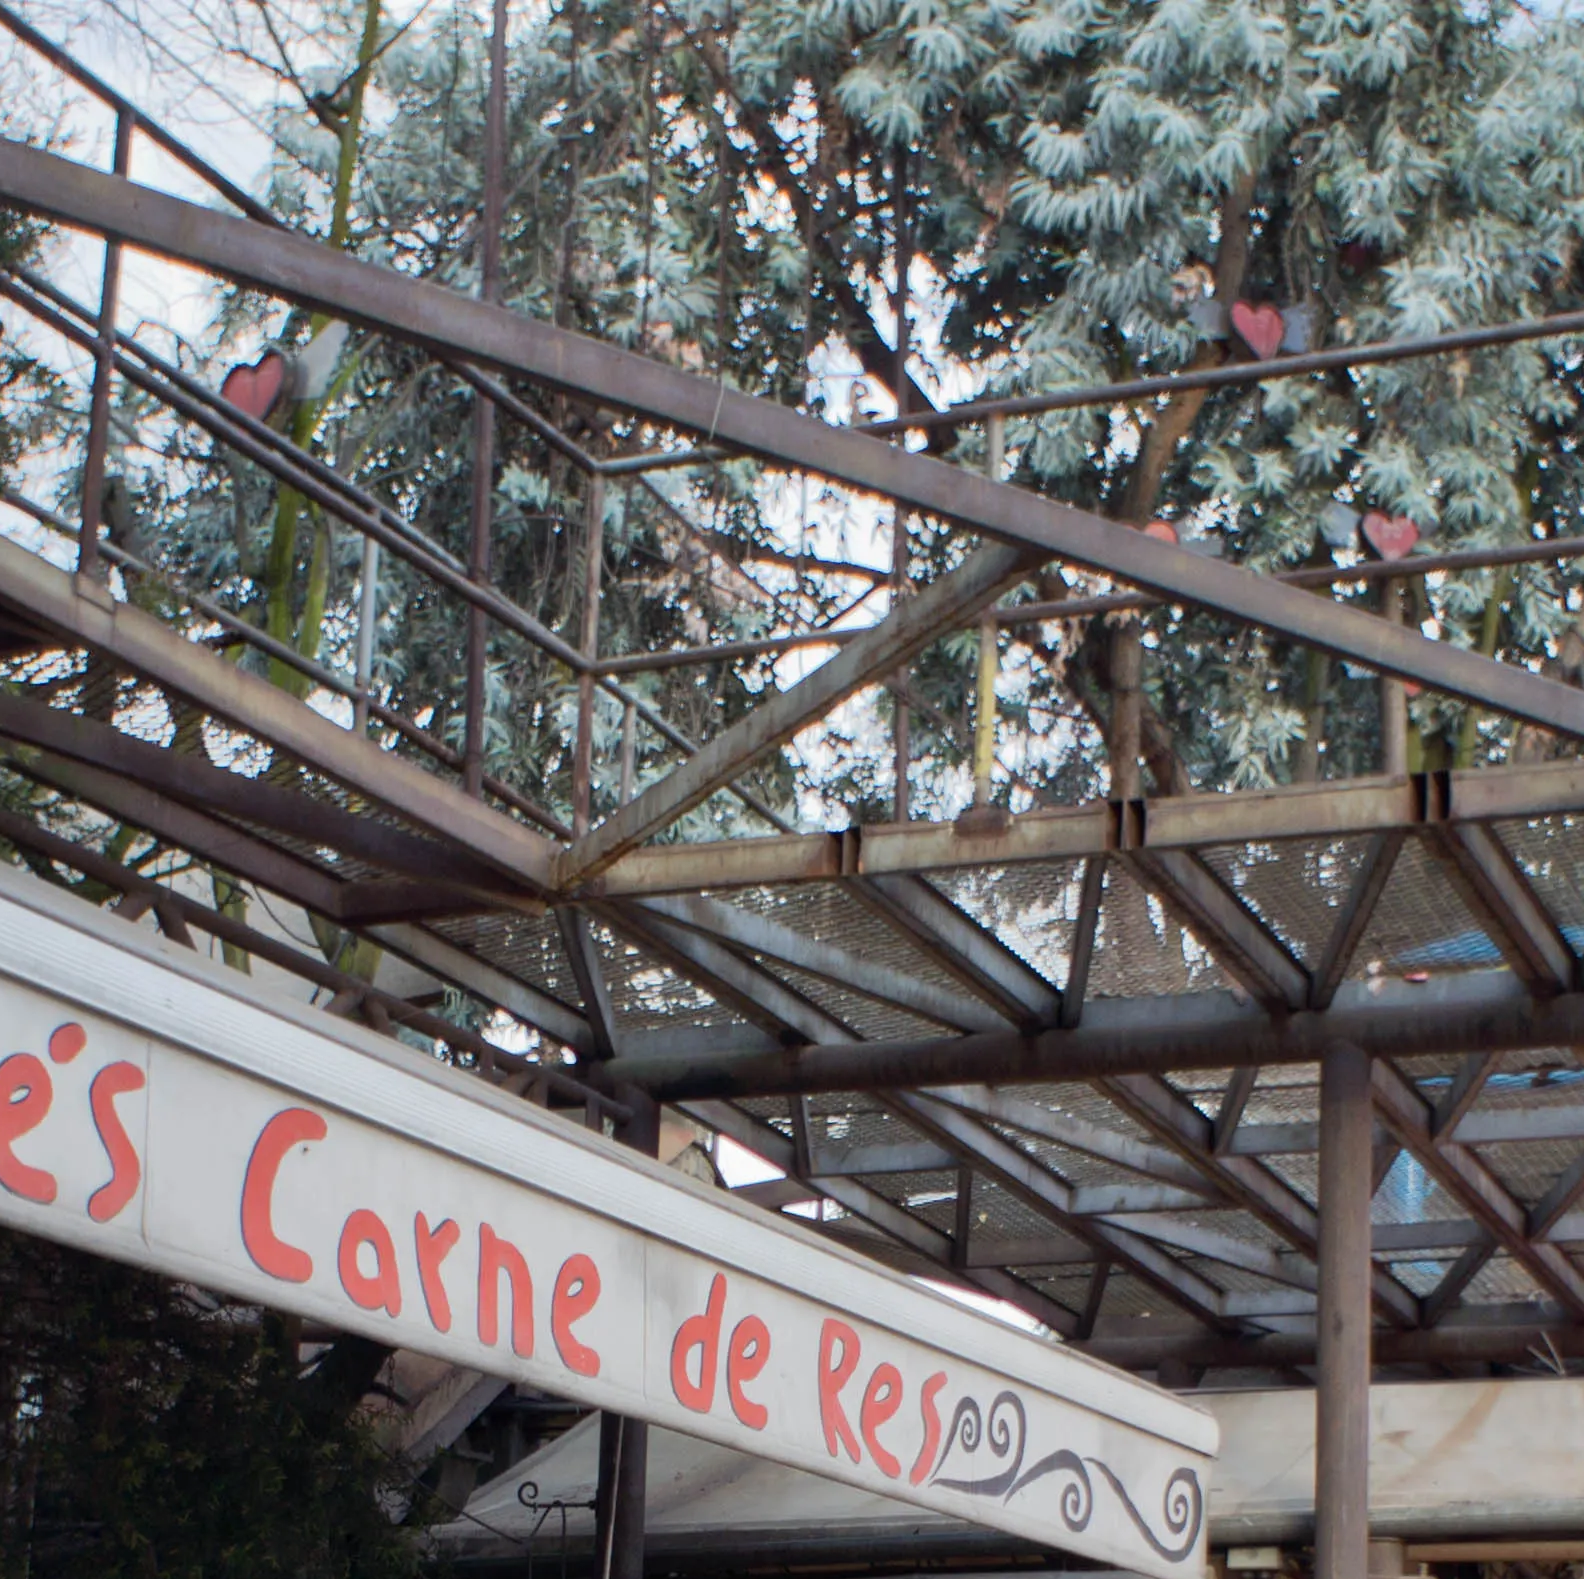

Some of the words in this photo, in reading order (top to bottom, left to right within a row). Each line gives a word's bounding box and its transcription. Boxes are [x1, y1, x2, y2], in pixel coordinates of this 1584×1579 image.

[239, 1107, 602, 1378] Carne
[669, 1271, 771, 1432] de
[818, 1318, 951, 1488] Res
